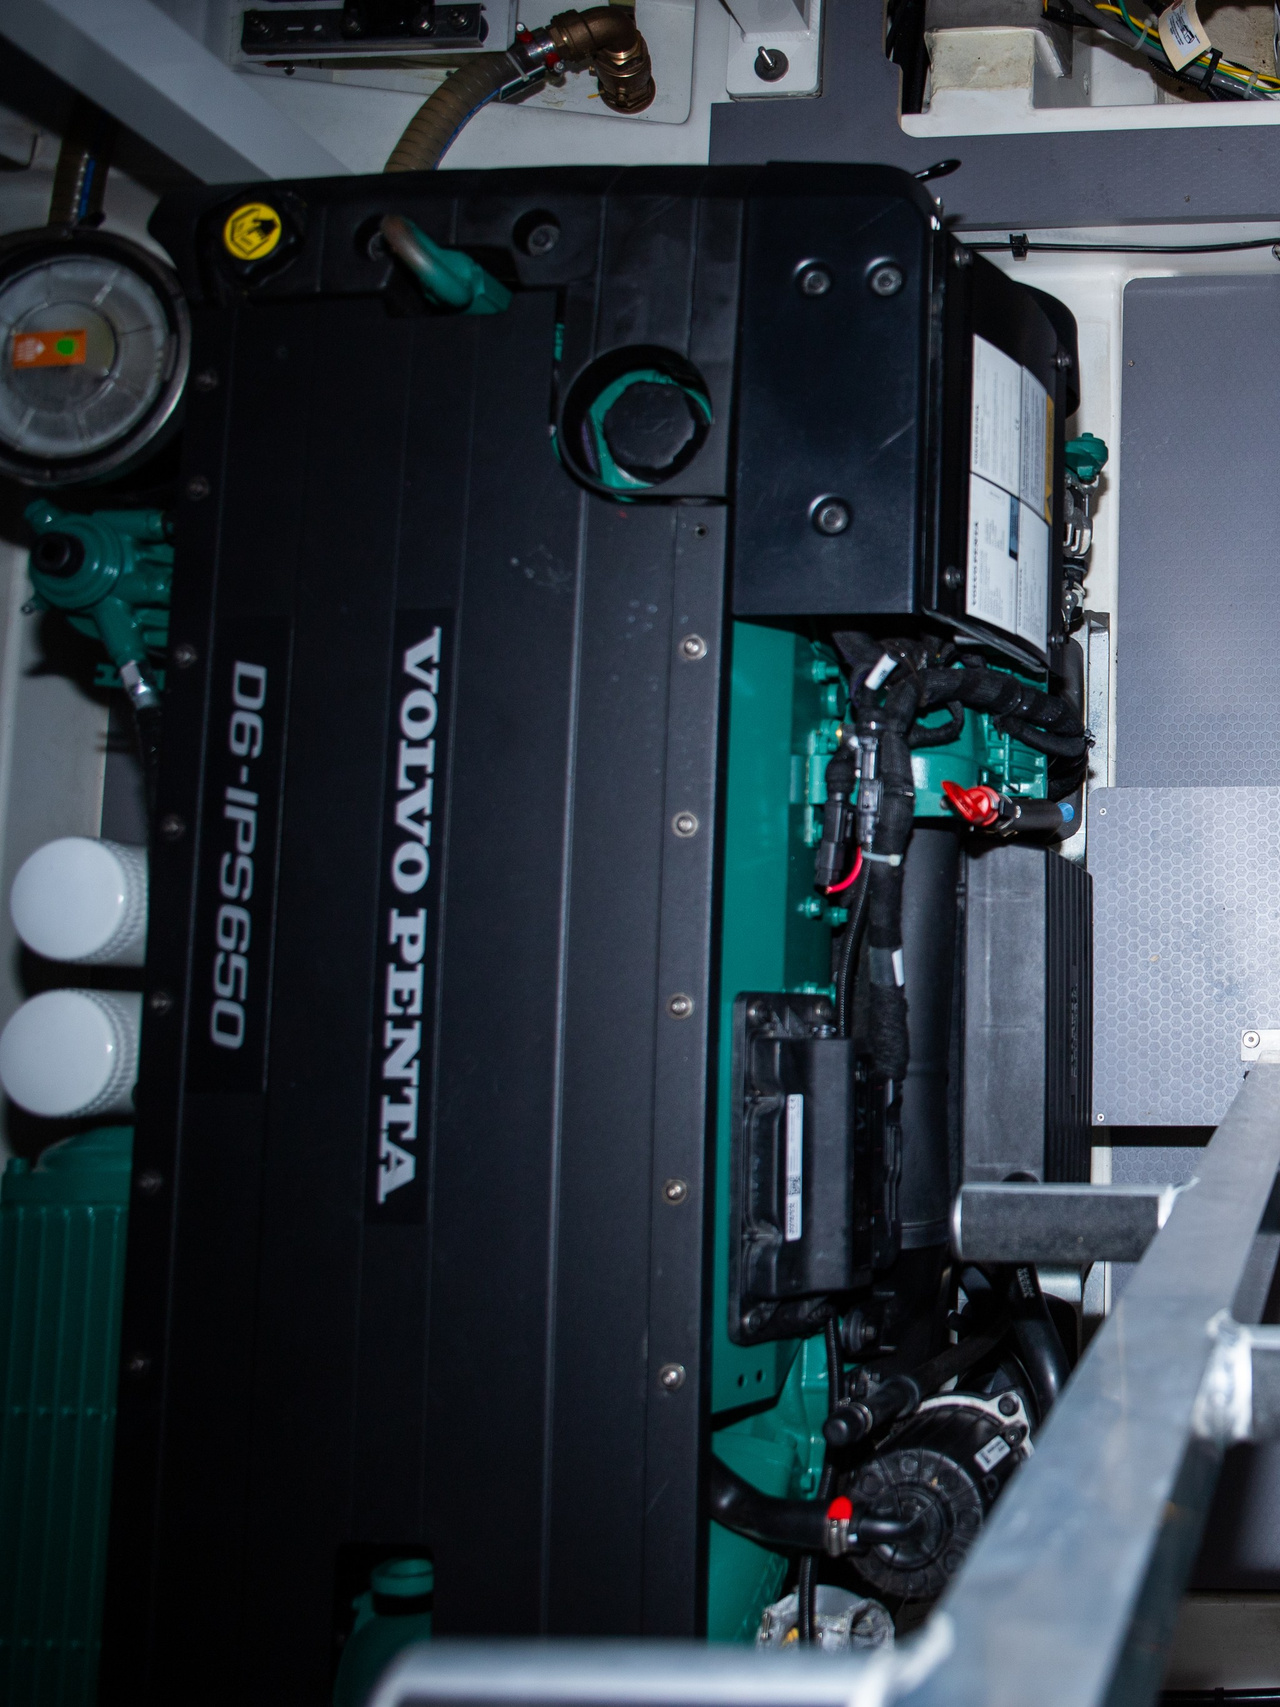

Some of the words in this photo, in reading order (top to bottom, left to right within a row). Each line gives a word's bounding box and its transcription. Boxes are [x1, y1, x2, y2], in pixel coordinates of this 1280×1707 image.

[210, 661, 267, 1049] D6-IPS650
[390, 626, 442, 895] VOLVO
[377, 908, 427, 1205] PENTA
